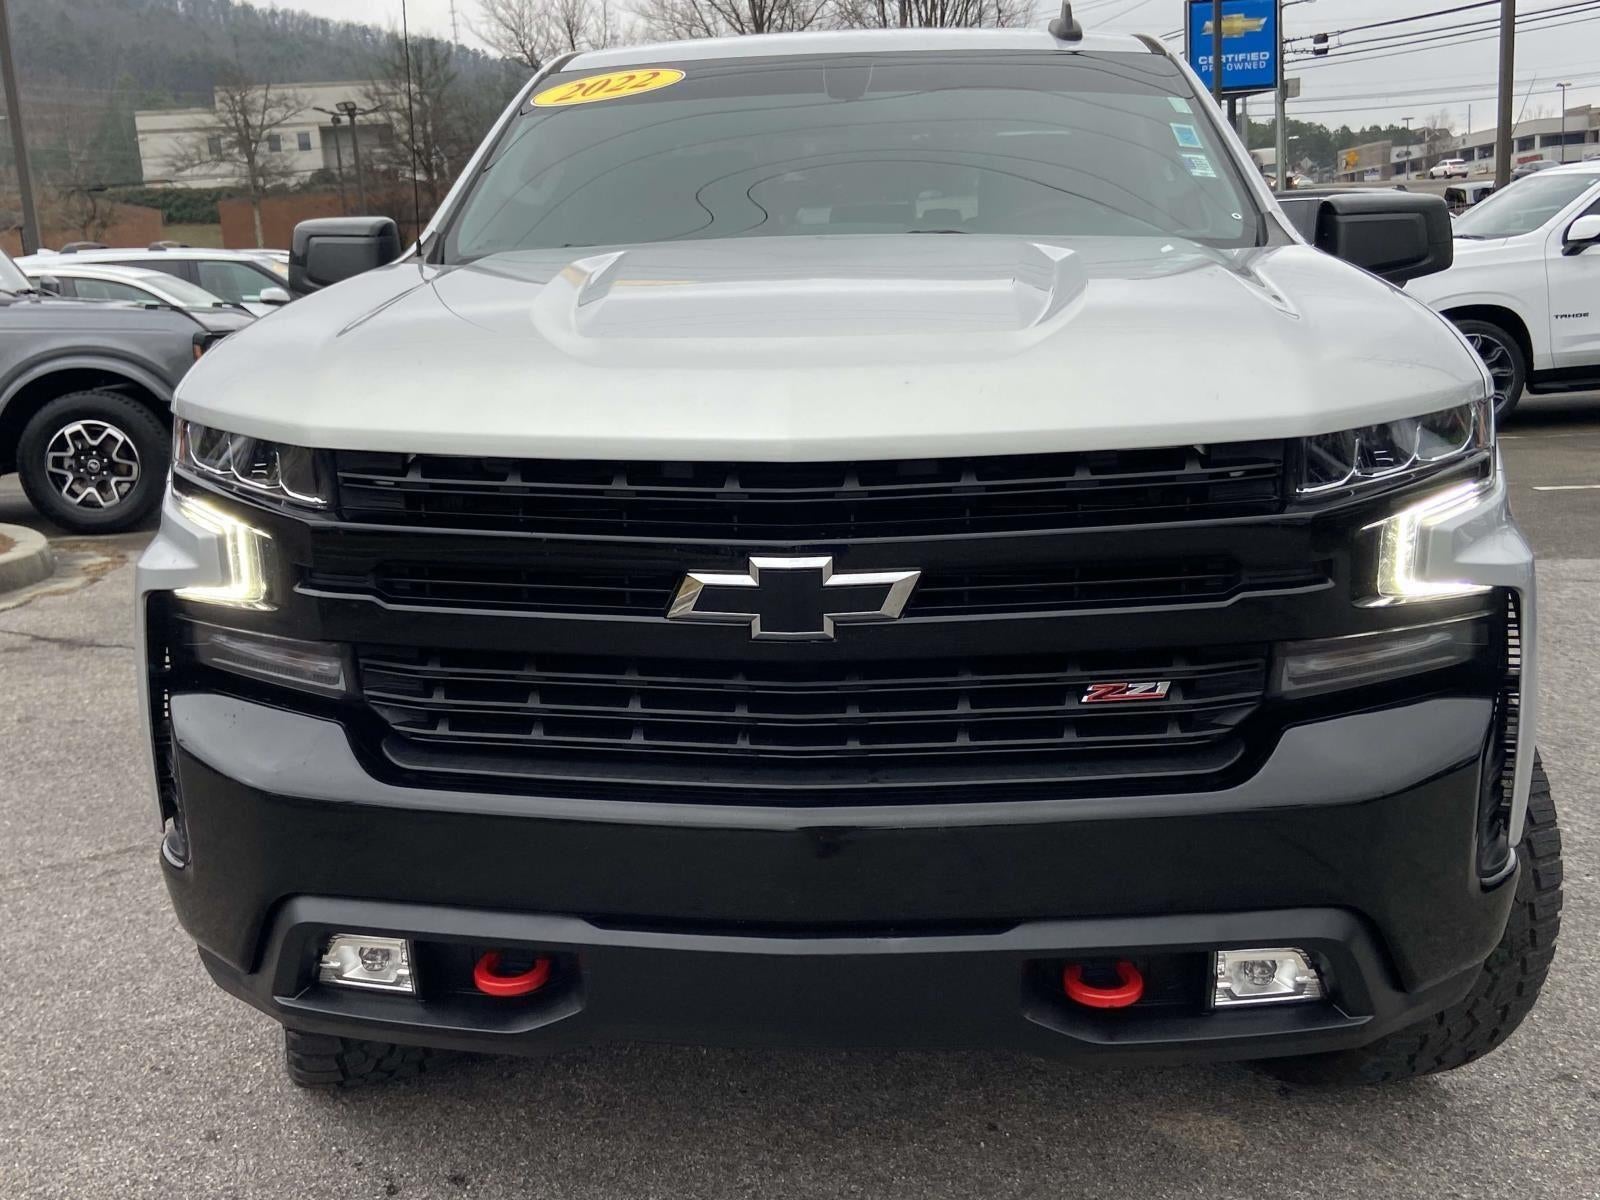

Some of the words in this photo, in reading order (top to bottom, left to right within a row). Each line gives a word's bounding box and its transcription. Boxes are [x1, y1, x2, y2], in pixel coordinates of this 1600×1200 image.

[1201, 60, 1266, 72] PR-OWNED
[553, 71, 661, 103] 2022
[1081, 681, 1171, 703] Z71
